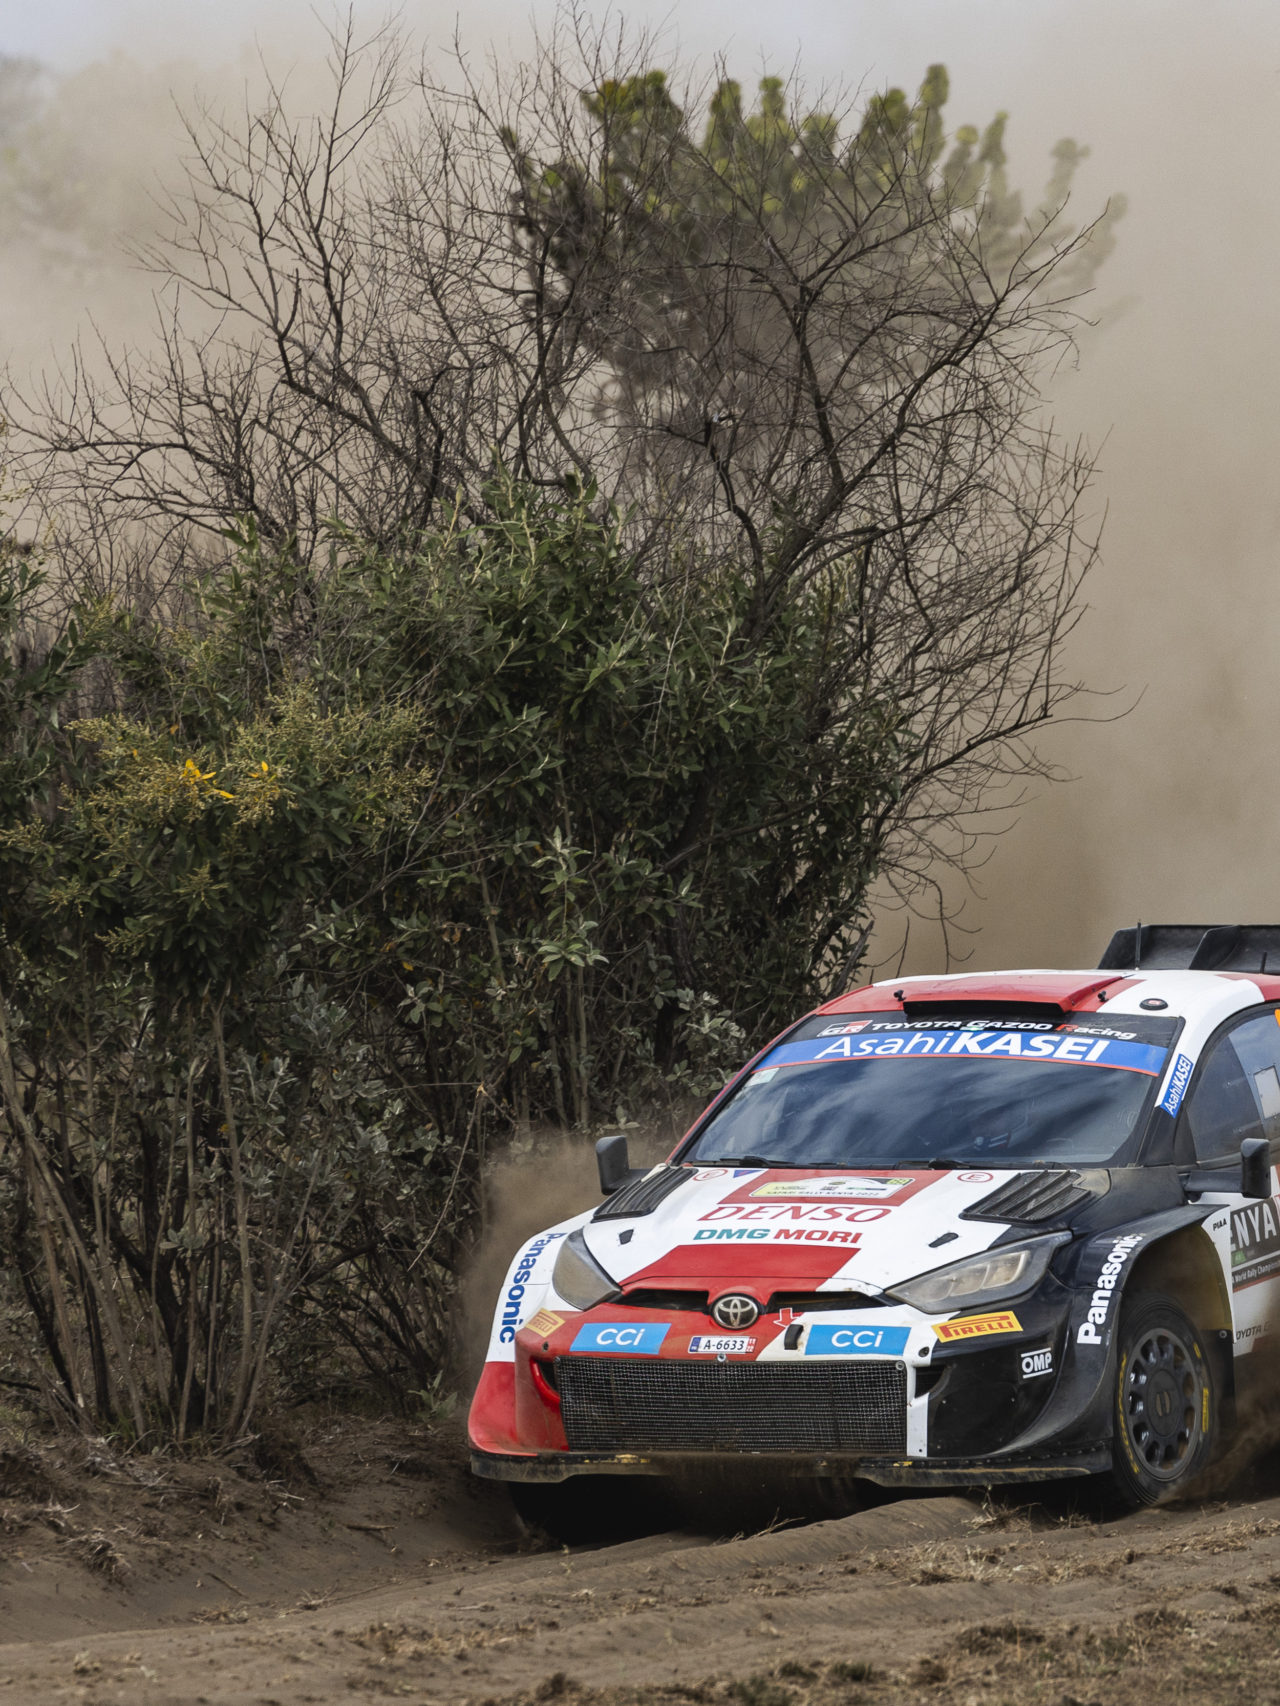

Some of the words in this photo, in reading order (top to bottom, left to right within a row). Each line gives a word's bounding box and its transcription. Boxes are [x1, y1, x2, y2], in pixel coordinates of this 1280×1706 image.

[872, 1021, 962, 1030] TOYOTA
[966, 1020, 1053, 1031] GAZOO
[1055, 1024, 1137, 1040] Racing
[814, 1032, 1110, 1062] AsahiKASEI
[1164, 1055, 1192, 1116] AsahiKASEI
[697, 1205, 892, 1222] DENSO
[1212, 1217, 1227, 1231] PIAA
[692, 1228, 771, 1240] DMG
[773, 1228, 863, 1244] MORI
[500, 1232, 567, 1343] Panasonic
[1077, 1235, 1143, 1345] Panasonic
[939, 1315, 1014, 1338] PIRELLI
[703, 1340, 745, 1350] A-6633
[1021, 1352, 1053, 1374] OMP
